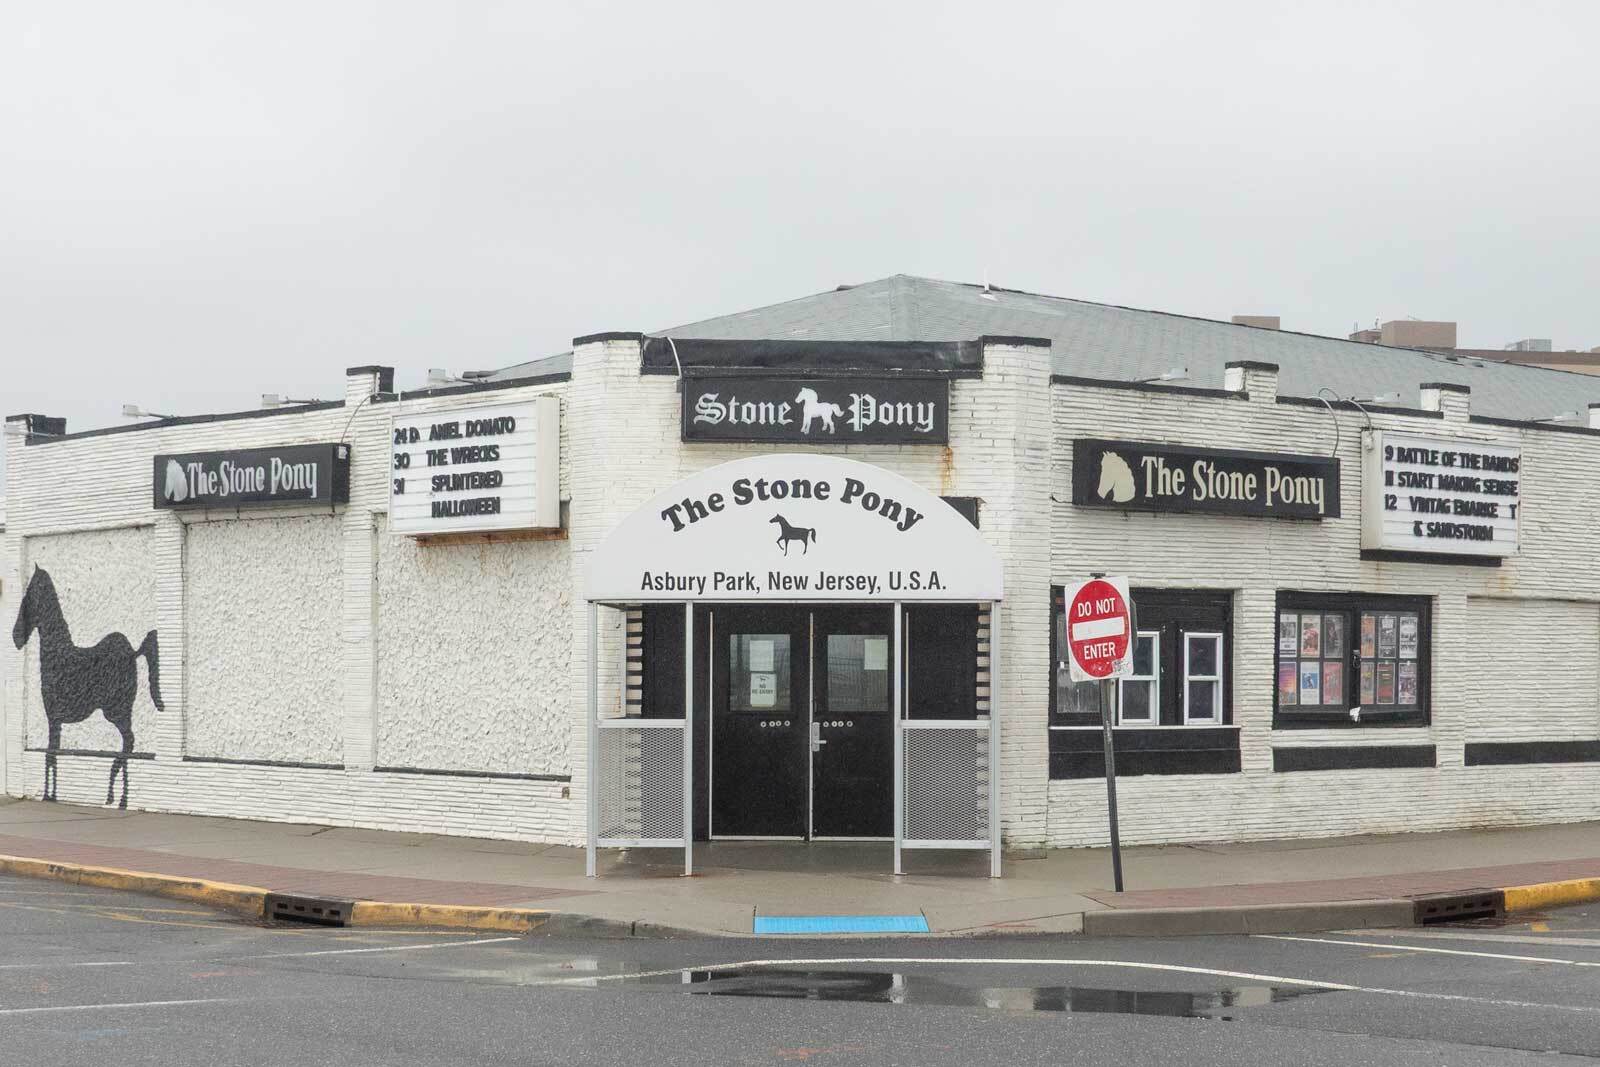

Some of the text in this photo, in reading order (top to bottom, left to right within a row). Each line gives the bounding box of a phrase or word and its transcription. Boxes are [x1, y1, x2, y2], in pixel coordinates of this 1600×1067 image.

[693, 392, 936, 433] Stone Pony
[465, 416, 516, 437] DONATO
[394, 444, 500, 470] 30 THE WRECKS
[1384, 445, 1519, 474] 9 BATTLE OF THE BANDS
[187, 457, 318, 498] The Stone Pony
[394, 469, 503, 495] 31 SPLINTERED
[1141, 456, 1325, 514] The Stone Pony
[1397, 471, 1436, 489] START
[1438, 474, 1481, 494] MAKING
[1483, 478, 1519, 497] SENSE
[431, 496, 501, 518] HALLOWEEN
[661, 477, 925, 533] The Stone Pony
[1384, 494, 1398, 511] 12
[1426, 522, 1494, 541] SANDSTORM
[641, 571, 947, 595] Asbury Park, New Jersey, U.S.A.
[1077, 598, 1116, 618] DO NOT
[1083, 641, 1116, 660] ENTER
